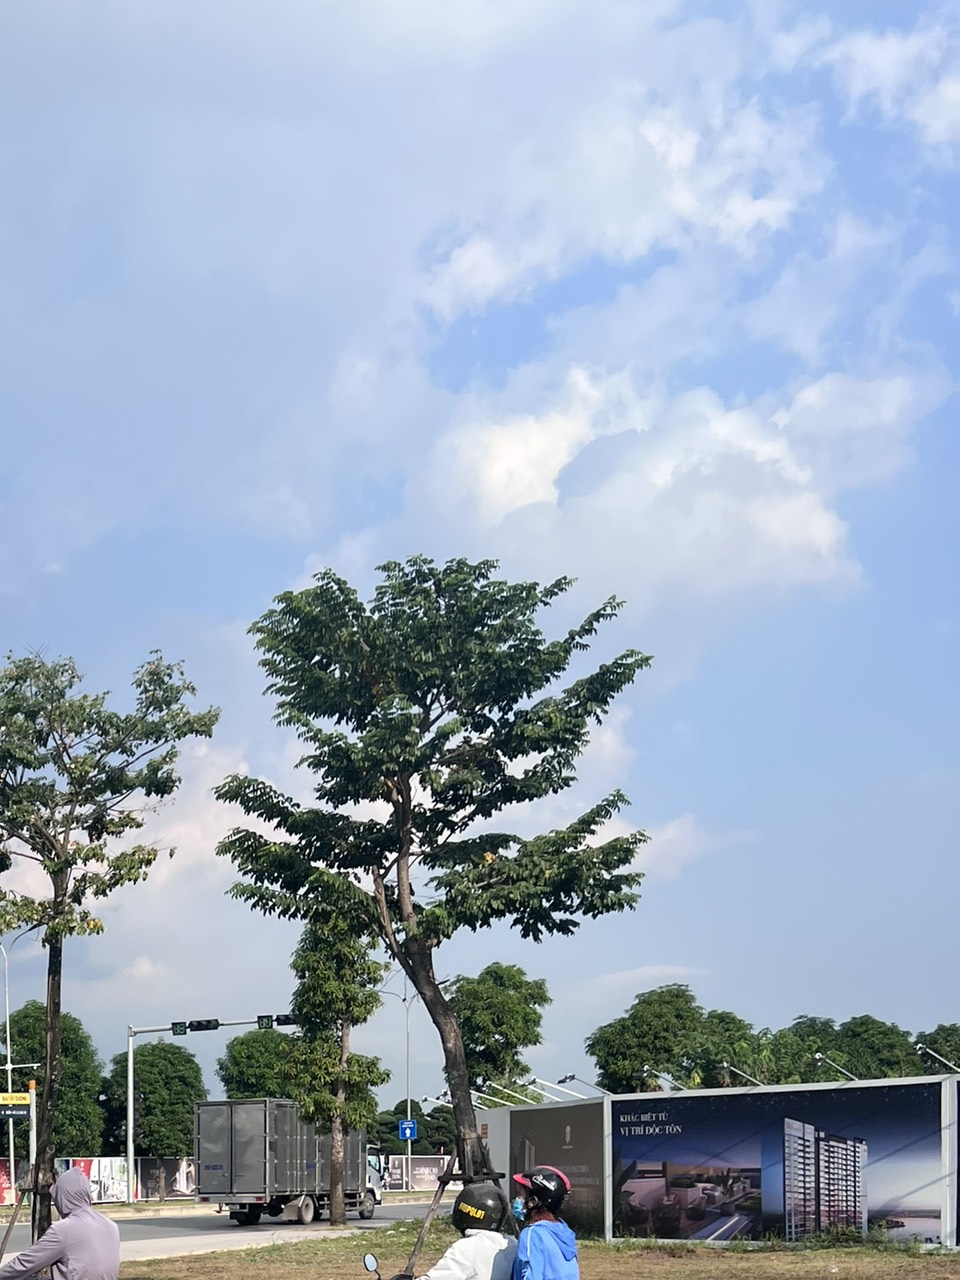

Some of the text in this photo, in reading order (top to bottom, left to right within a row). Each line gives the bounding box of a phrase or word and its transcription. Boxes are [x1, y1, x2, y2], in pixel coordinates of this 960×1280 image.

[620, 1112, 640, 1122] KHÁC
[641, 1112, 657, 1122] BIỆT
[620, 1126, 629, 1137] VỊ
[630, 1124, 644, 1135] TRÍ
[645, 1124, 663, 1136] ĐỘC
